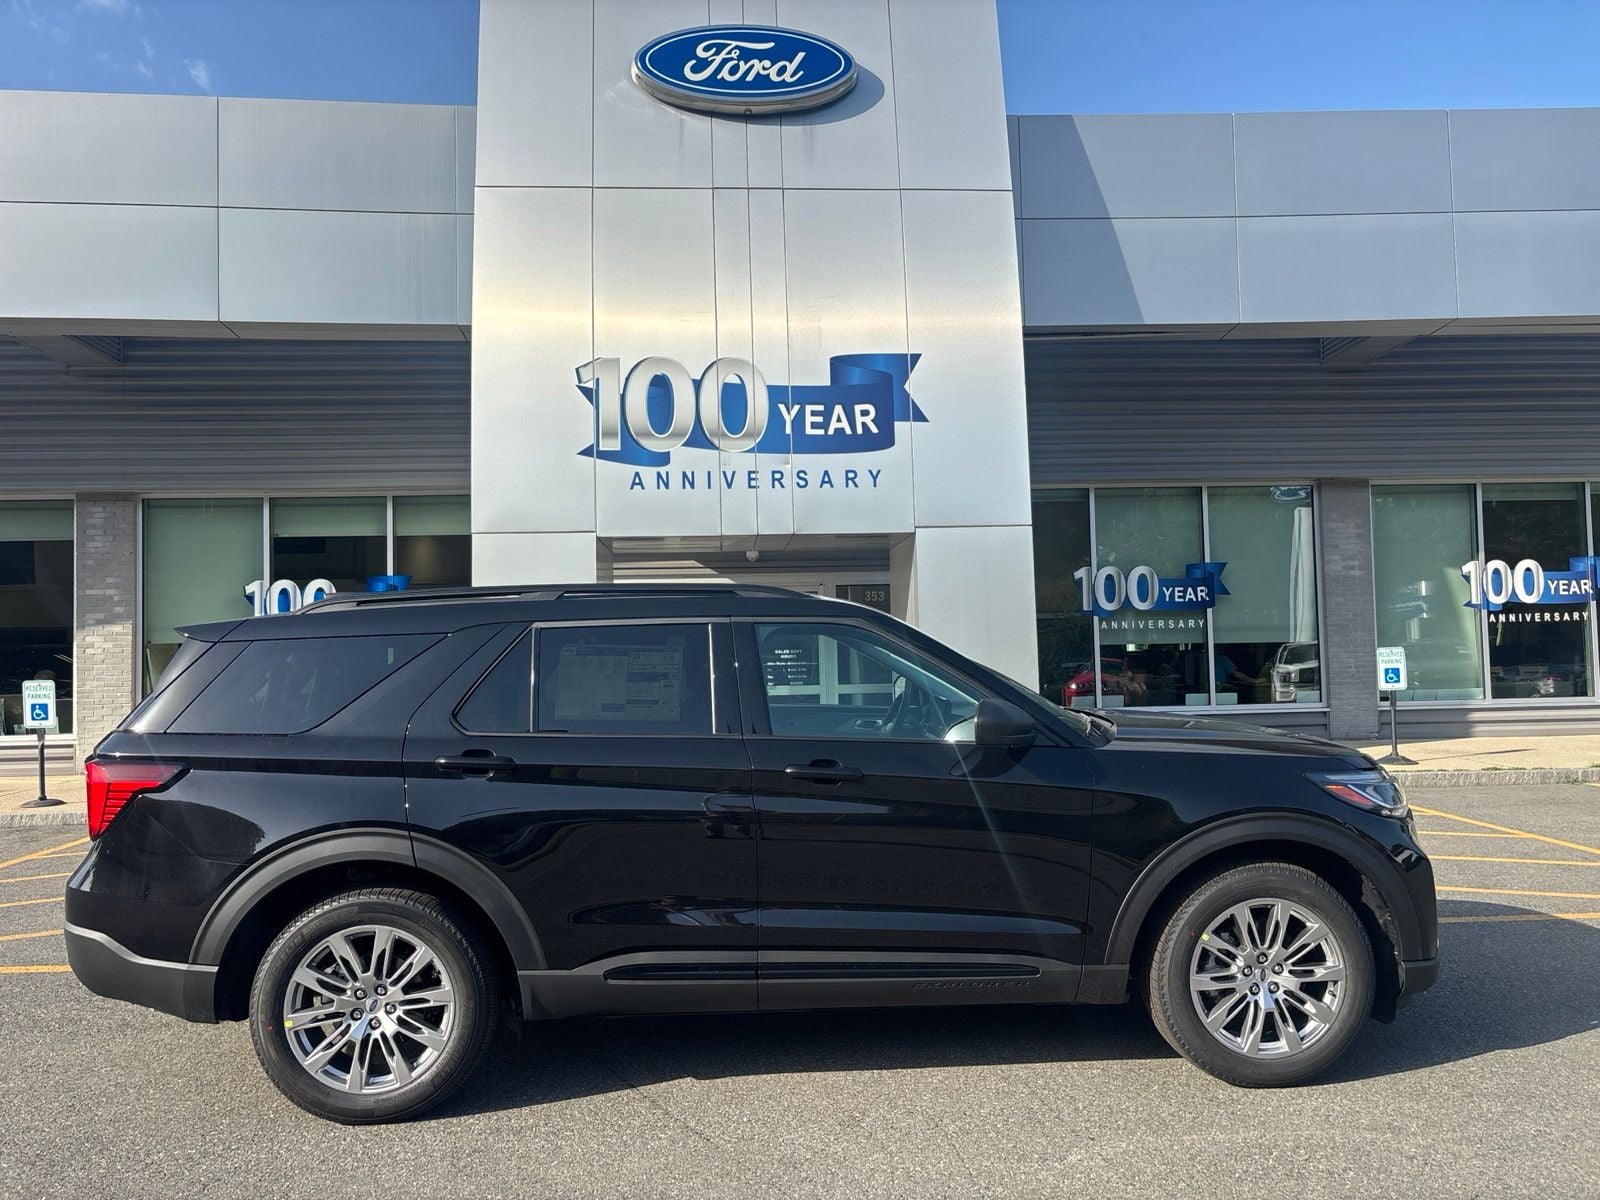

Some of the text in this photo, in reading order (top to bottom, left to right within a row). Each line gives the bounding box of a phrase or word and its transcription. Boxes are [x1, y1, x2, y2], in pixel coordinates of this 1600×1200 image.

[684, 39, 807, 84] Ford
[575, 356, 880, 453] 100 YEAR
[629, 469, 882, 491] ANNIVERSARY
[864, 590, 885, 602] 353
[1073, 565, 1210, 611] 100 YEAR
[1460, 558, 1594, 604] 100 YEAR
[1101, 619, 1206, 630] ANNIVERSARY
[1489, 611, 1590, 623] ANNIVERSARY
